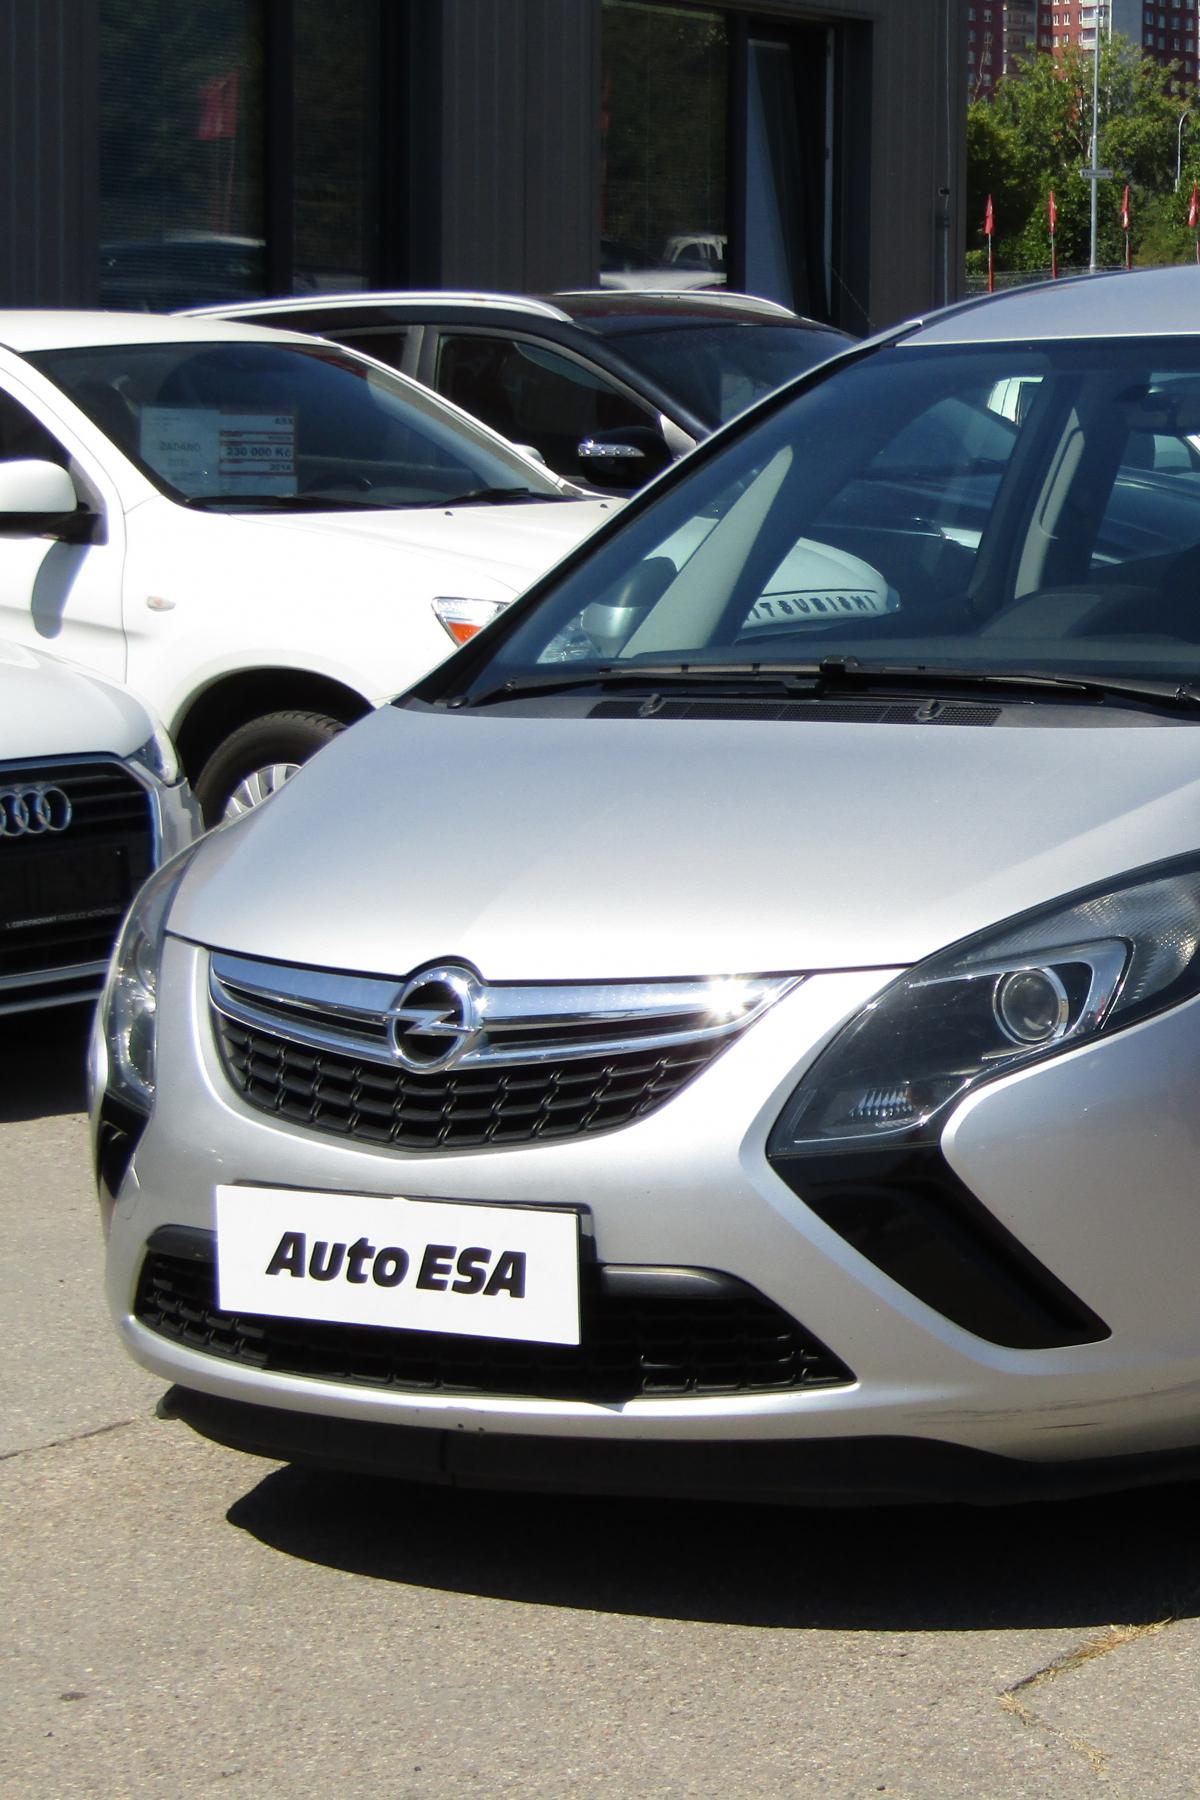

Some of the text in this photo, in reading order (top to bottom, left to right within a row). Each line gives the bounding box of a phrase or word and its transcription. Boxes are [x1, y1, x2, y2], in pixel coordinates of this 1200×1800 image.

[226, 447, 247, 457] 230
[251, 447, 273, 457] 000
[746, 595, 878, 621] ITSUBISHI
[265, 1231, 527, 1299] Auto ESA
